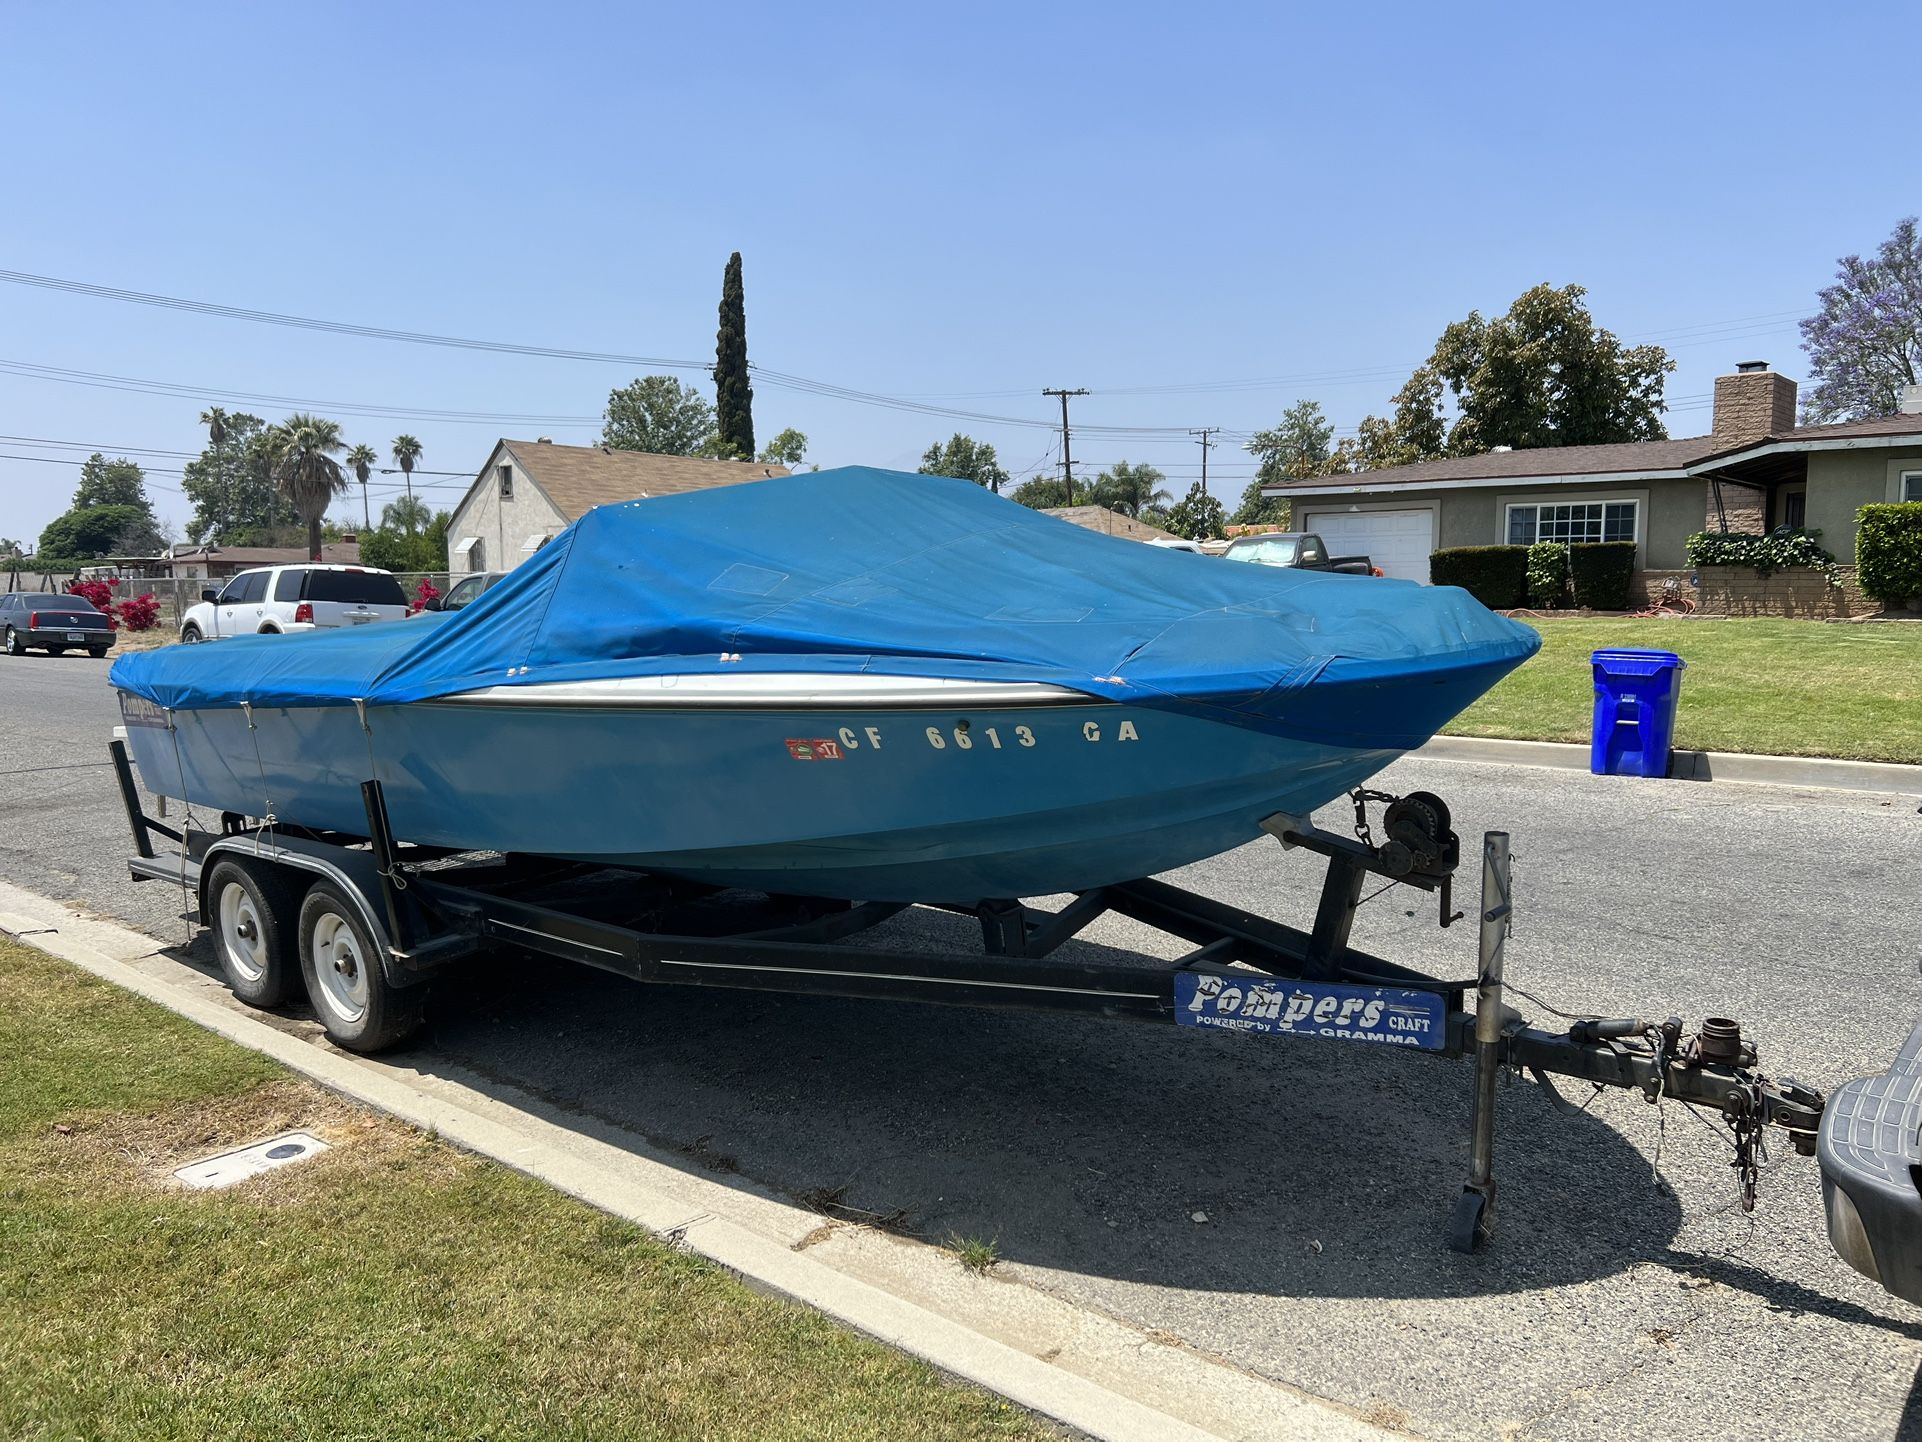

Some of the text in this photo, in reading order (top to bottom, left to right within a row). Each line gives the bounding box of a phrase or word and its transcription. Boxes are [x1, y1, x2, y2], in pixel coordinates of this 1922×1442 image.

[838, 727, 882, 749] CF
[925, 725, 1036, 749] 6613
[1188, 975, 1385, 1029] Pompers
[1257, 1021, 1271, 1032] by
[1319, 1028, 1420, 1045] GRAMMA
[1389, 1016, 1430, 1033] CRAFT
